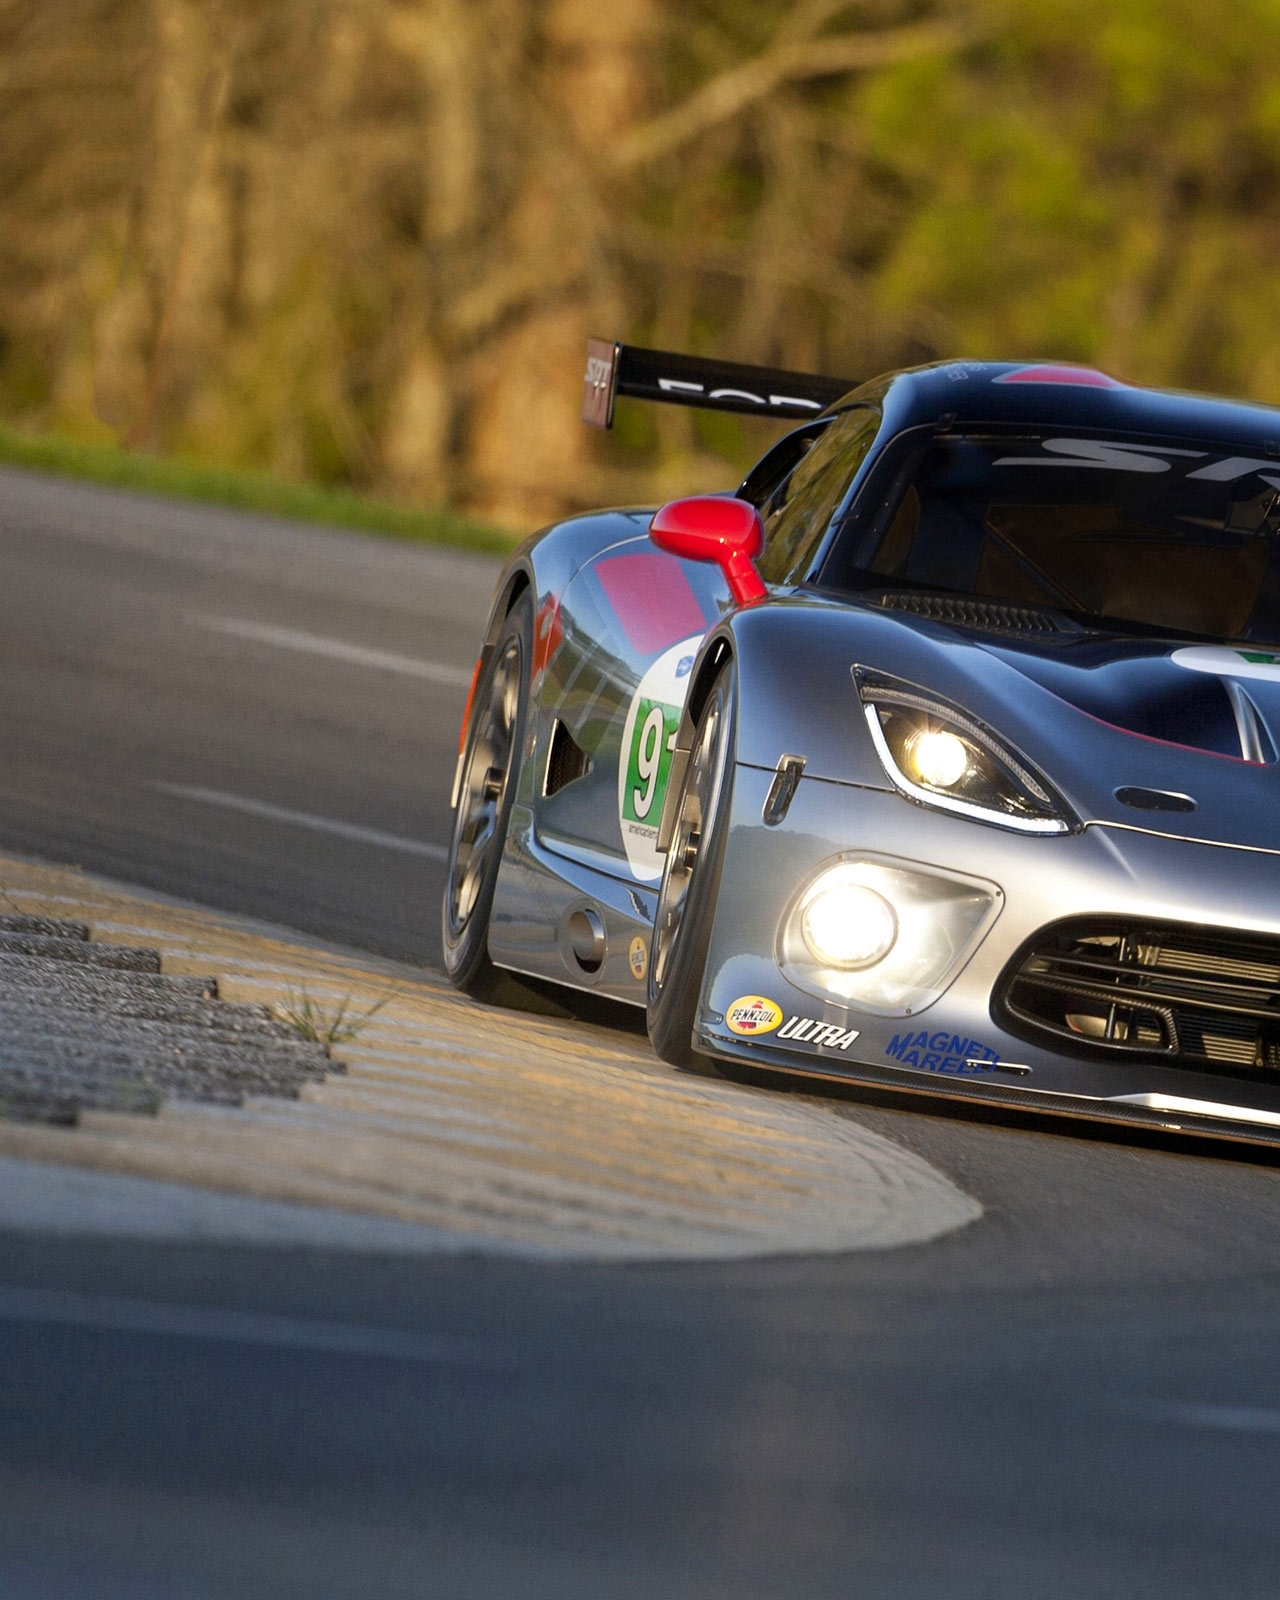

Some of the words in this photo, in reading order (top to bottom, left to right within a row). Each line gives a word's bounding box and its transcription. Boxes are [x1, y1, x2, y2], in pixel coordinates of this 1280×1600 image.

[633, 706, 679, 819] 9
[731, 1008, 776, 1023] PENNZOIL
[777, 1015, 860, 1050] ULTRA
[885, 1031, 1001, 1061] MAGNETI
